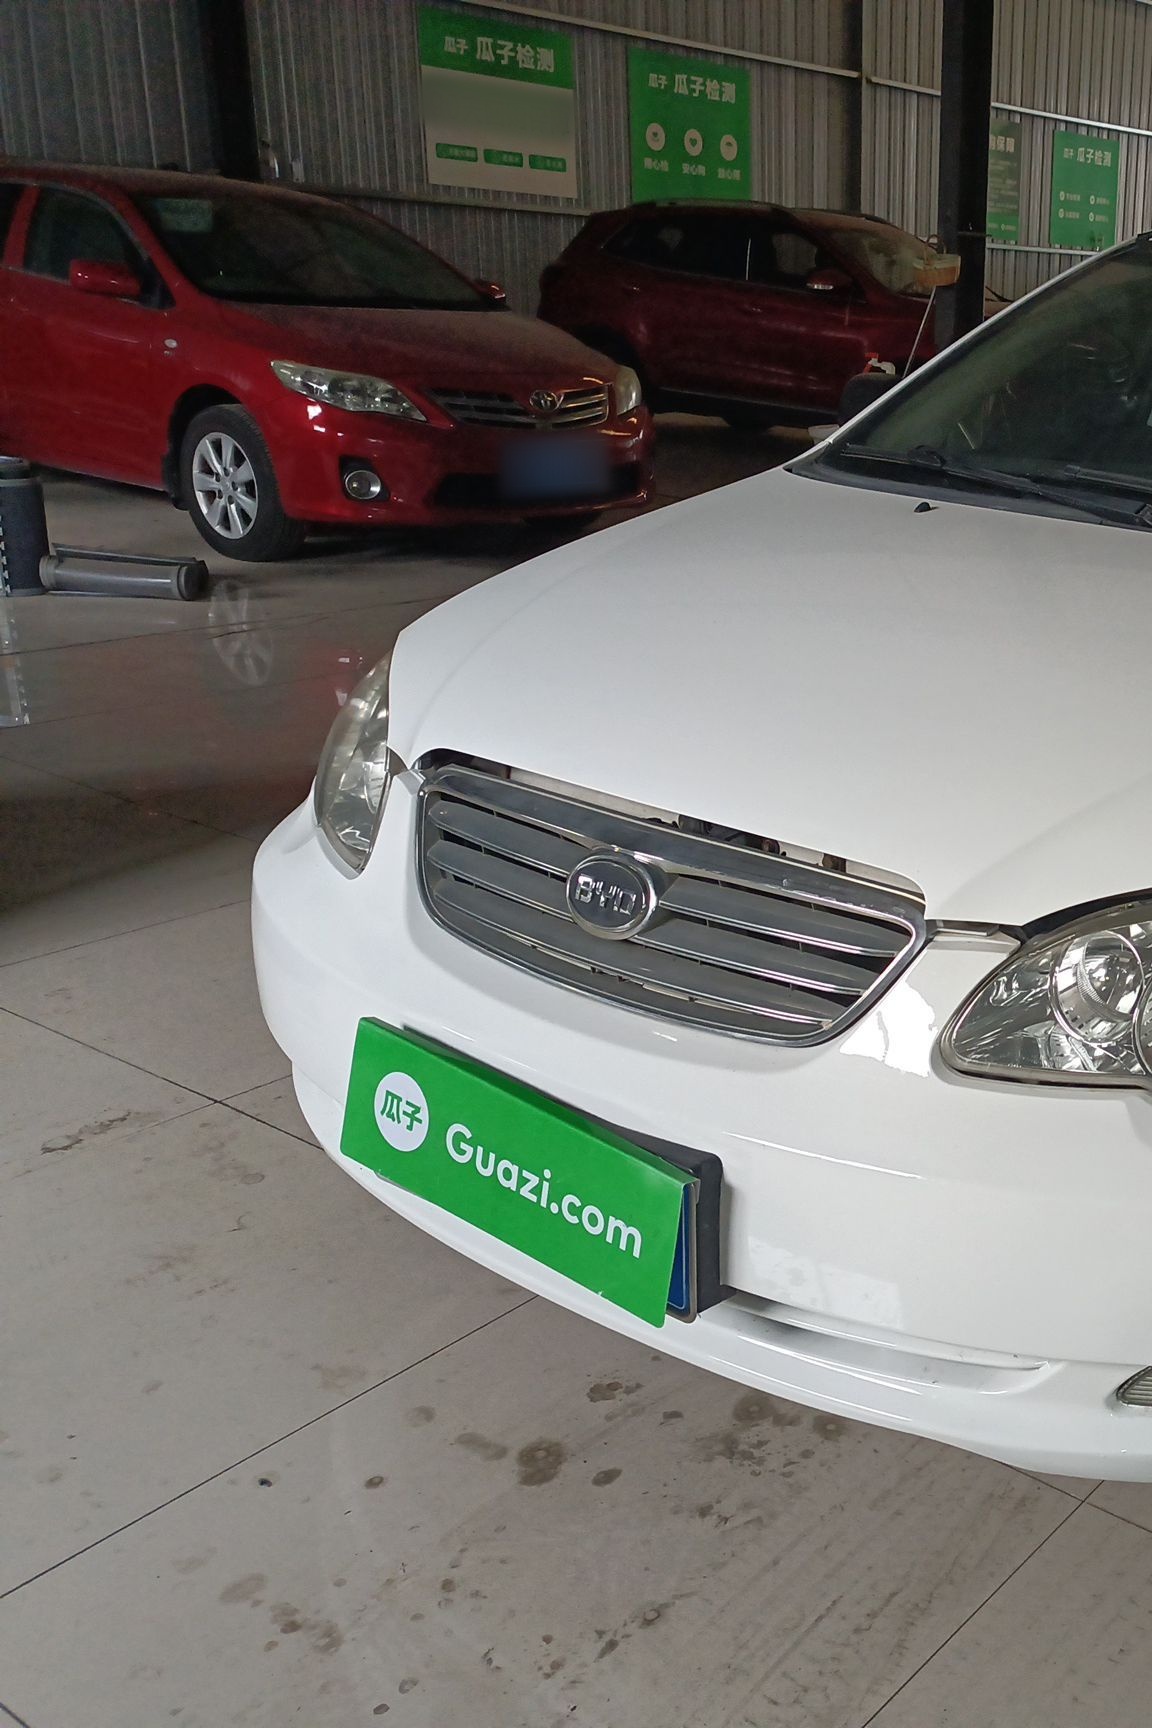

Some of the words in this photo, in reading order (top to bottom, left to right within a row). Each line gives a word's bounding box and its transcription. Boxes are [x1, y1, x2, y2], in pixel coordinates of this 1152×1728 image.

[444, 36, 468, 55] 瓜子
[476, 37, 555, 73] 瓜子检测
[648, 73, 668, 89] 瓜子
[674, 74, 736, 104] 瓜子检测
[1077, 147, 1112, 167] 瓜子检测
[575, 873, 637, 915] BYD
[380, 1089, 422, 1132] 瓜子
[445, 1123, 642, 1260] Guazi.com
